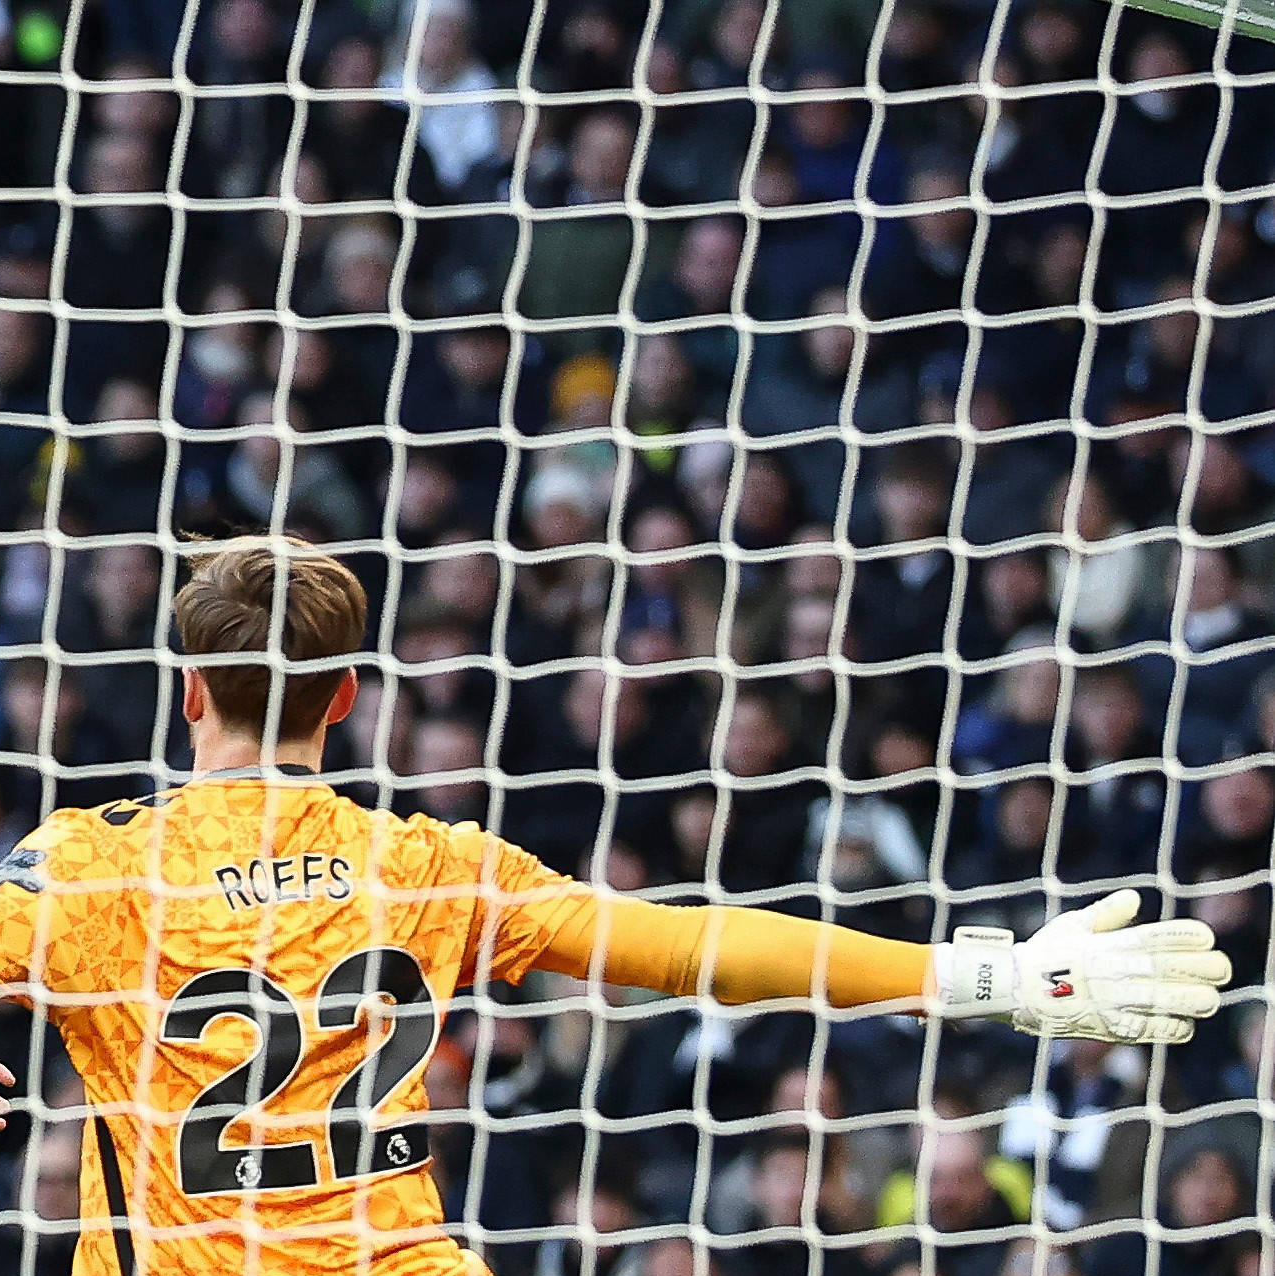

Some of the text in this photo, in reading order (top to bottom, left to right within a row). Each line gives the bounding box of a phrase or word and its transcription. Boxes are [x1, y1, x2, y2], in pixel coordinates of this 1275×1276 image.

[213, 854, 353, 912] ROEFS
[975, 962, 993, 1002] ROEFS
[161, 946, 440, 1198] 22
